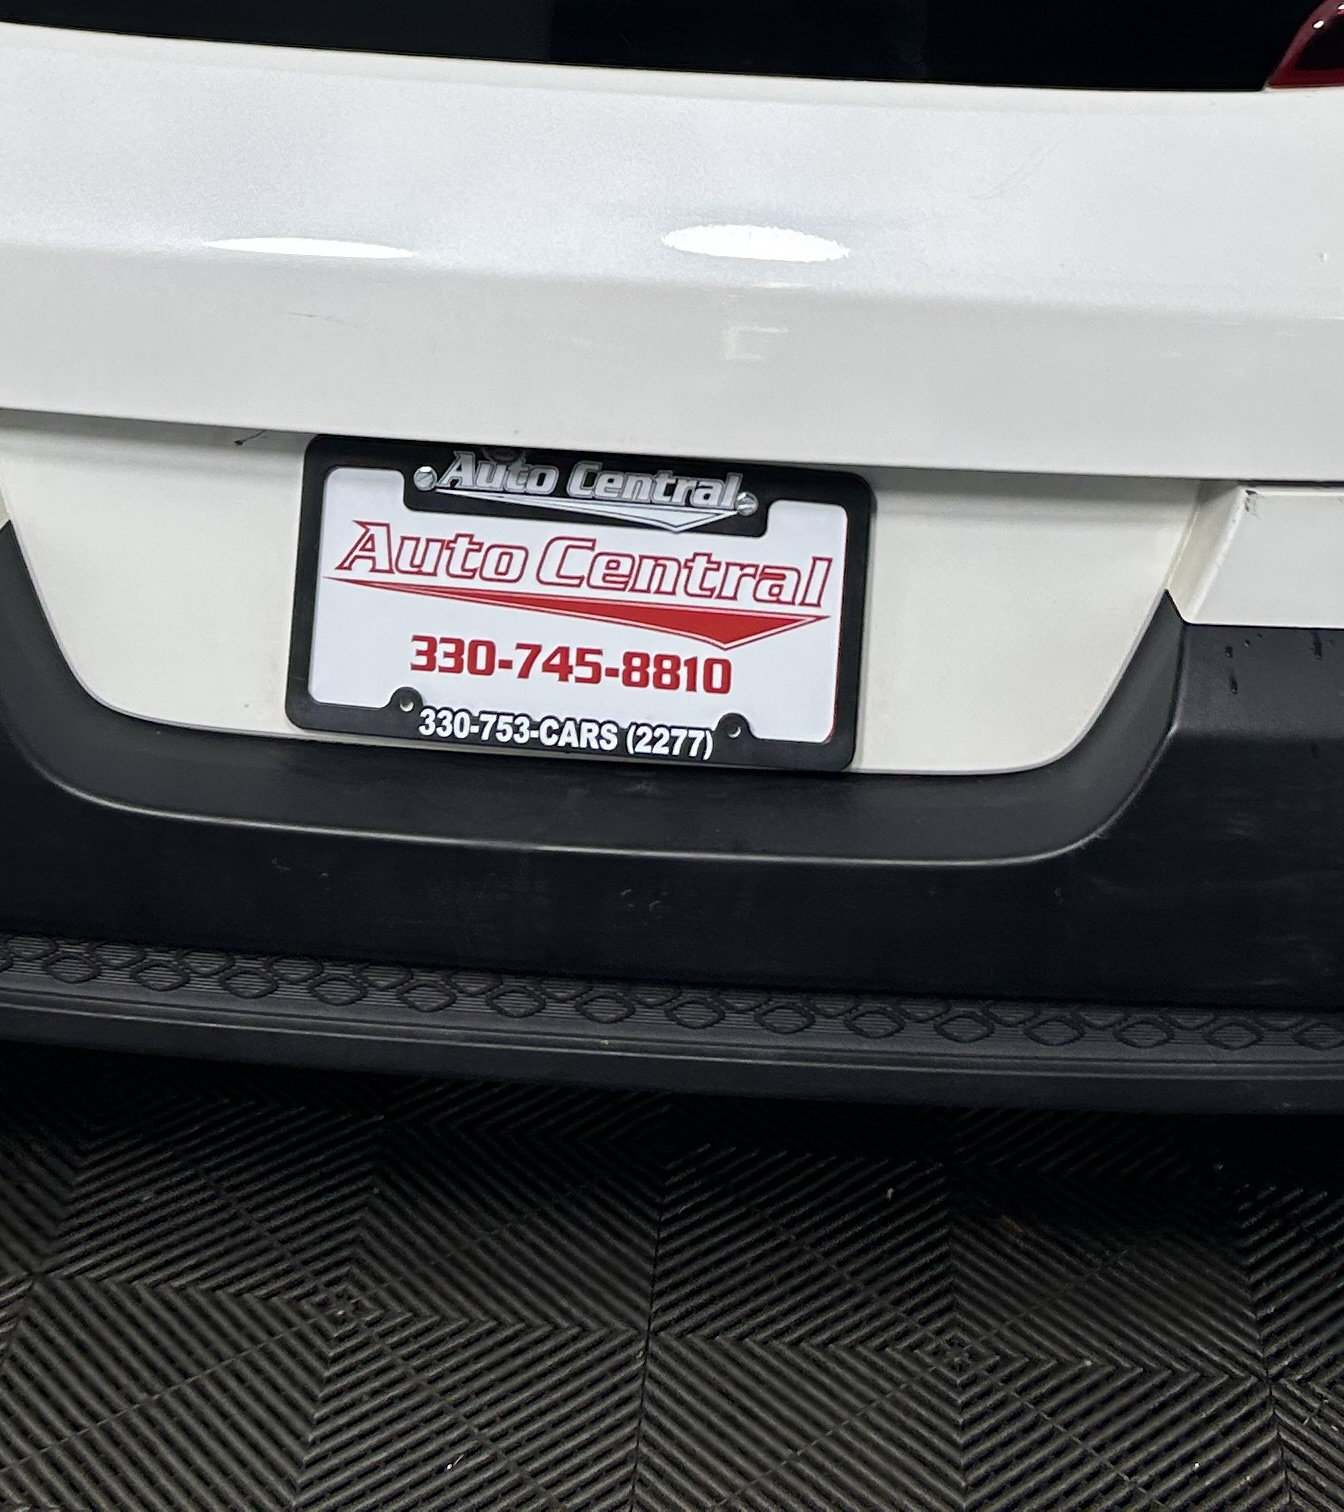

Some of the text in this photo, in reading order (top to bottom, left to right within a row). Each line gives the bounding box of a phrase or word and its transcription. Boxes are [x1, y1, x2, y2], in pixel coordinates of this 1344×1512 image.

[436, 451, 744, 510] Auto Central
[336, 520, 833, 607] Auto Central
[410, 635, 732, 694] 330-745-8810
[418, 709, 714, 760] 330-753-CARS (2277)
